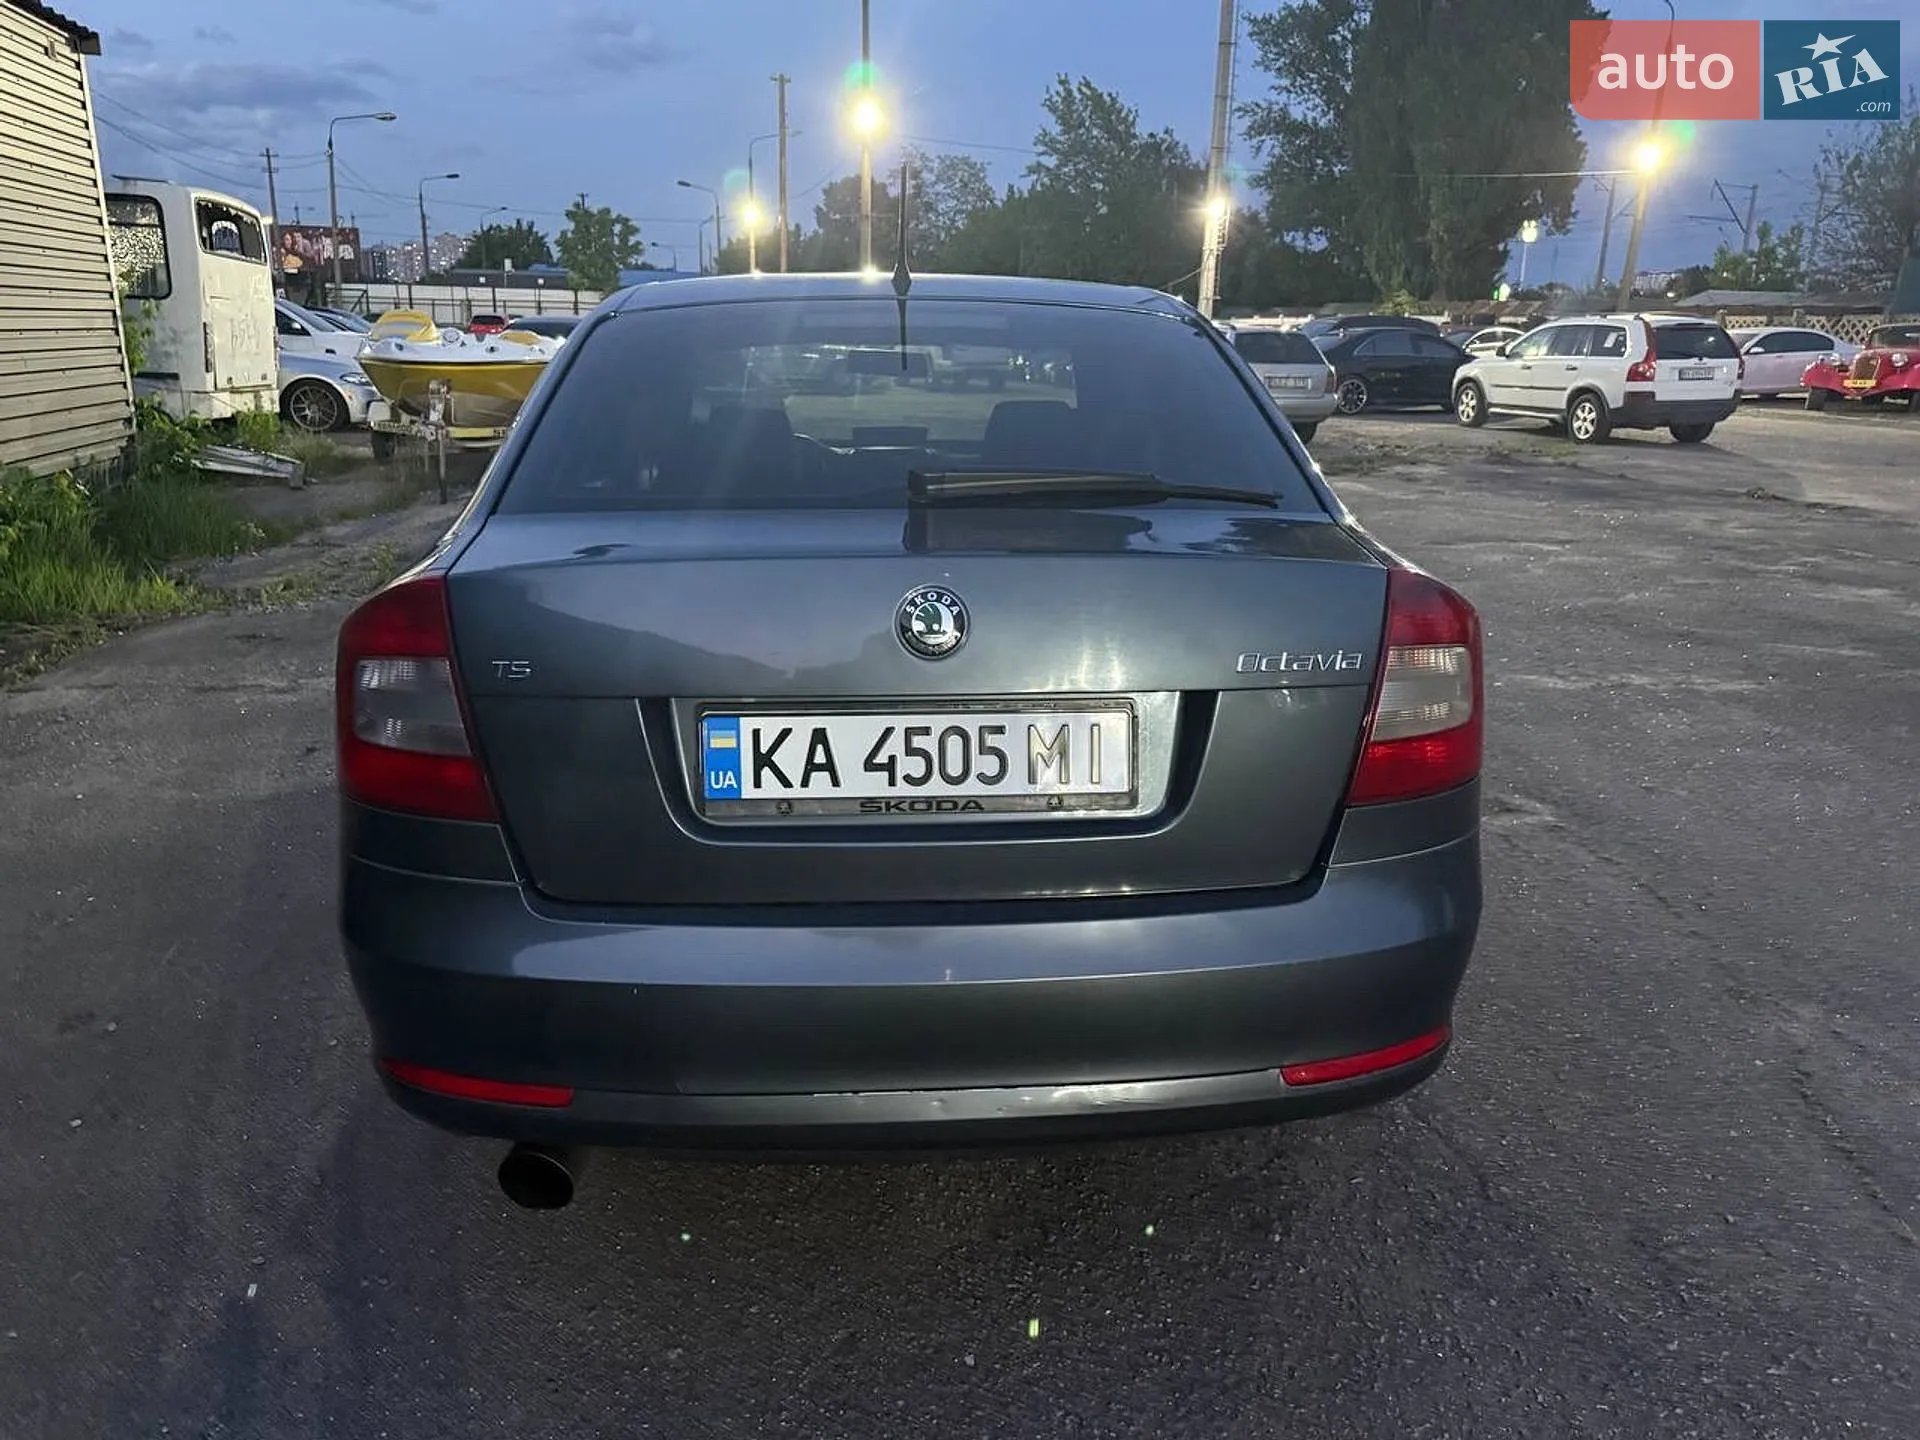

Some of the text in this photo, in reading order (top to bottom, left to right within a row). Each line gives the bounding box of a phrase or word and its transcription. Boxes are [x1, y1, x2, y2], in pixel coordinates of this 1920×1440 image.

[491, 660, 532, 678] TS
[1236, 650, 1363, 672] Octavia
[752, 723, 1101, 789] KA 4505 MI
[710, 771, 738, 788] UA
